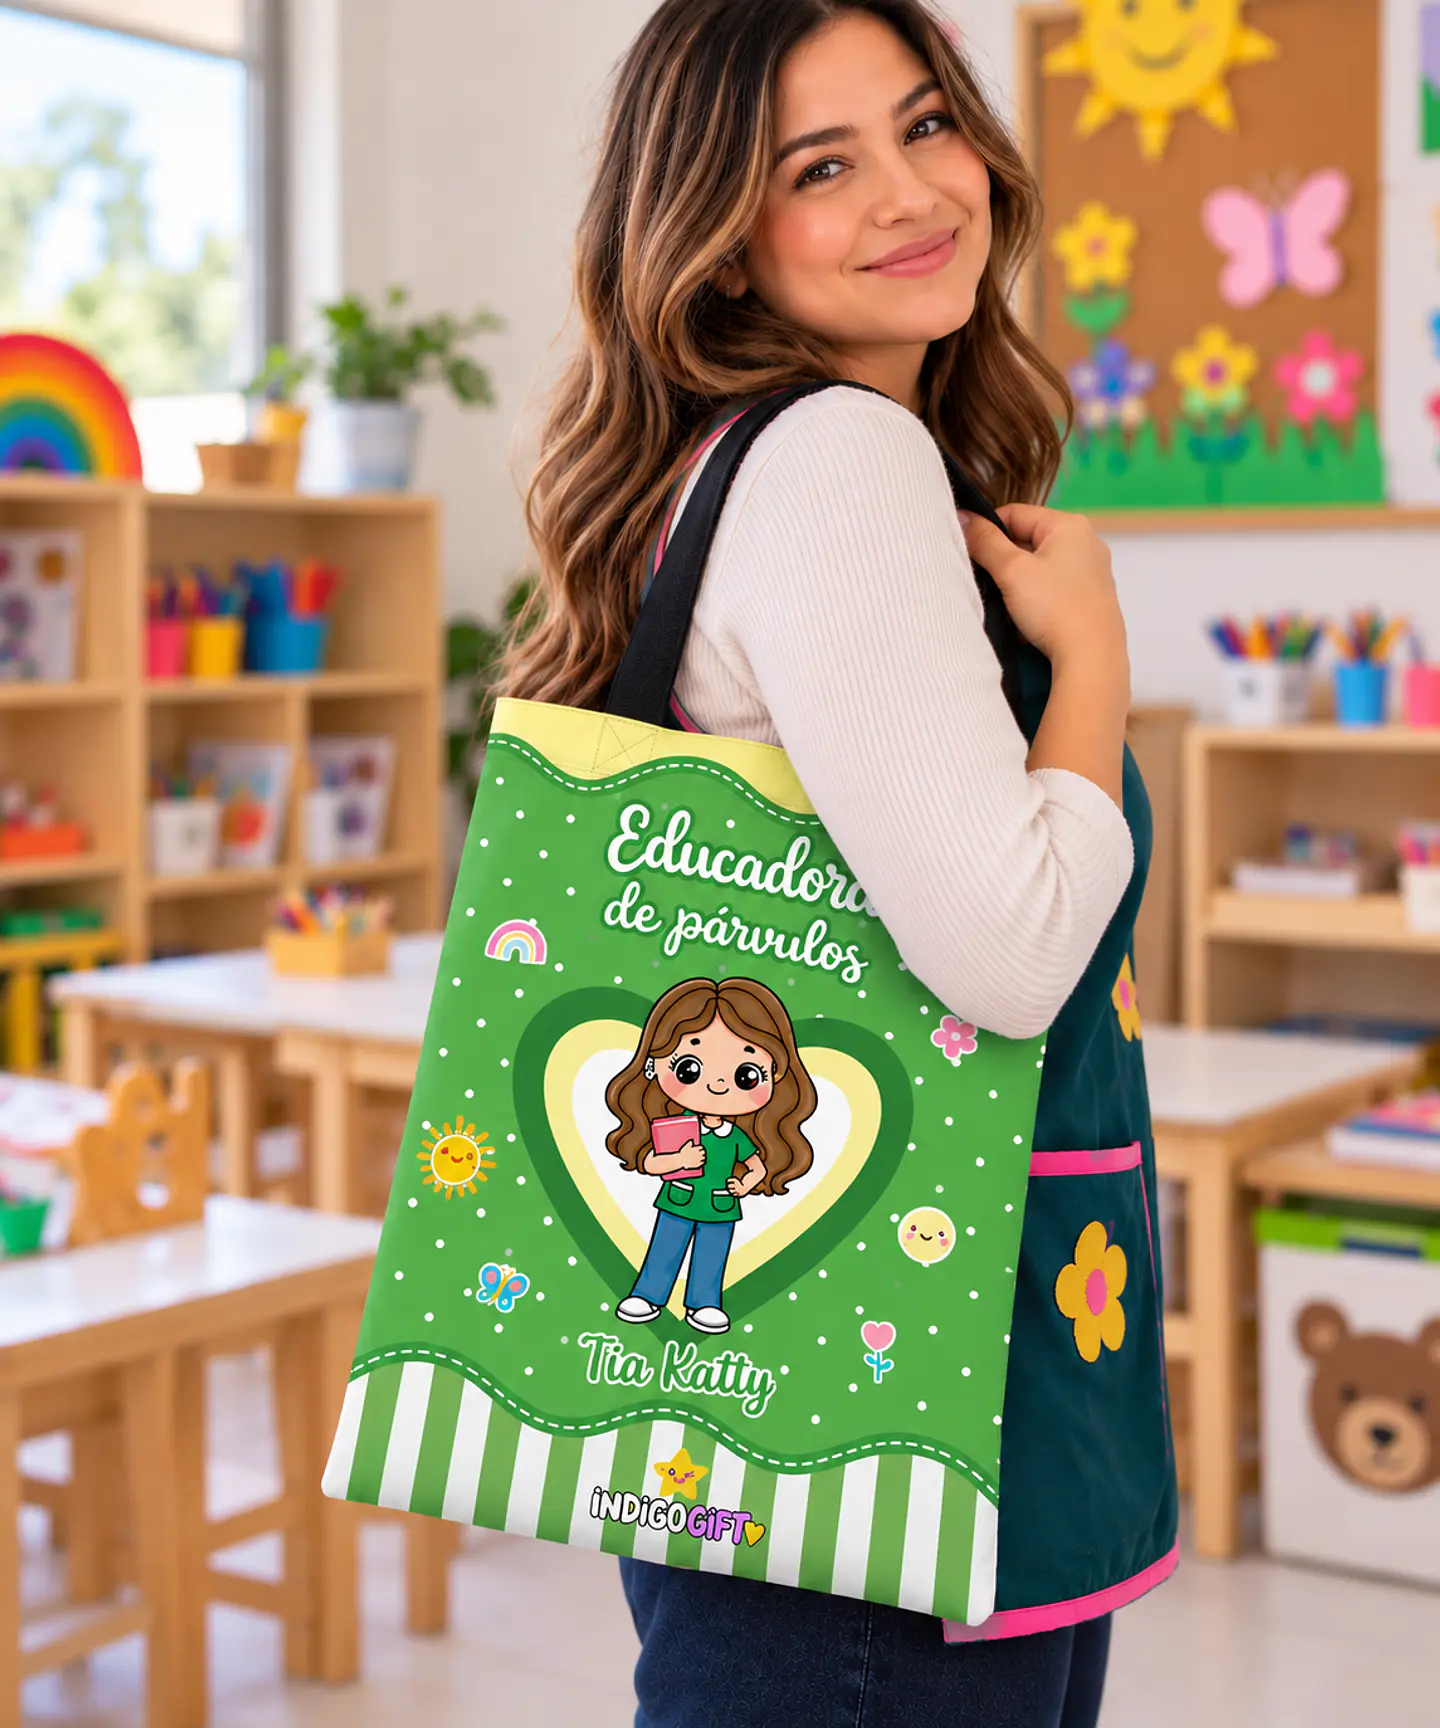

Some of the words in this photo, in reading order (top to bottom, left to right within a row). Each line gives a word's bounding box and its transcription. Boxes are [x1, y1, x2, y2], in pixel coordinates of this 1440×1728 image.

[607, 803, 879, 917] Educadora
[603, 881, 662, 933] de
[663, 906, 869, 983] párvulos
[660, 1340, 777, 1418] Katty
